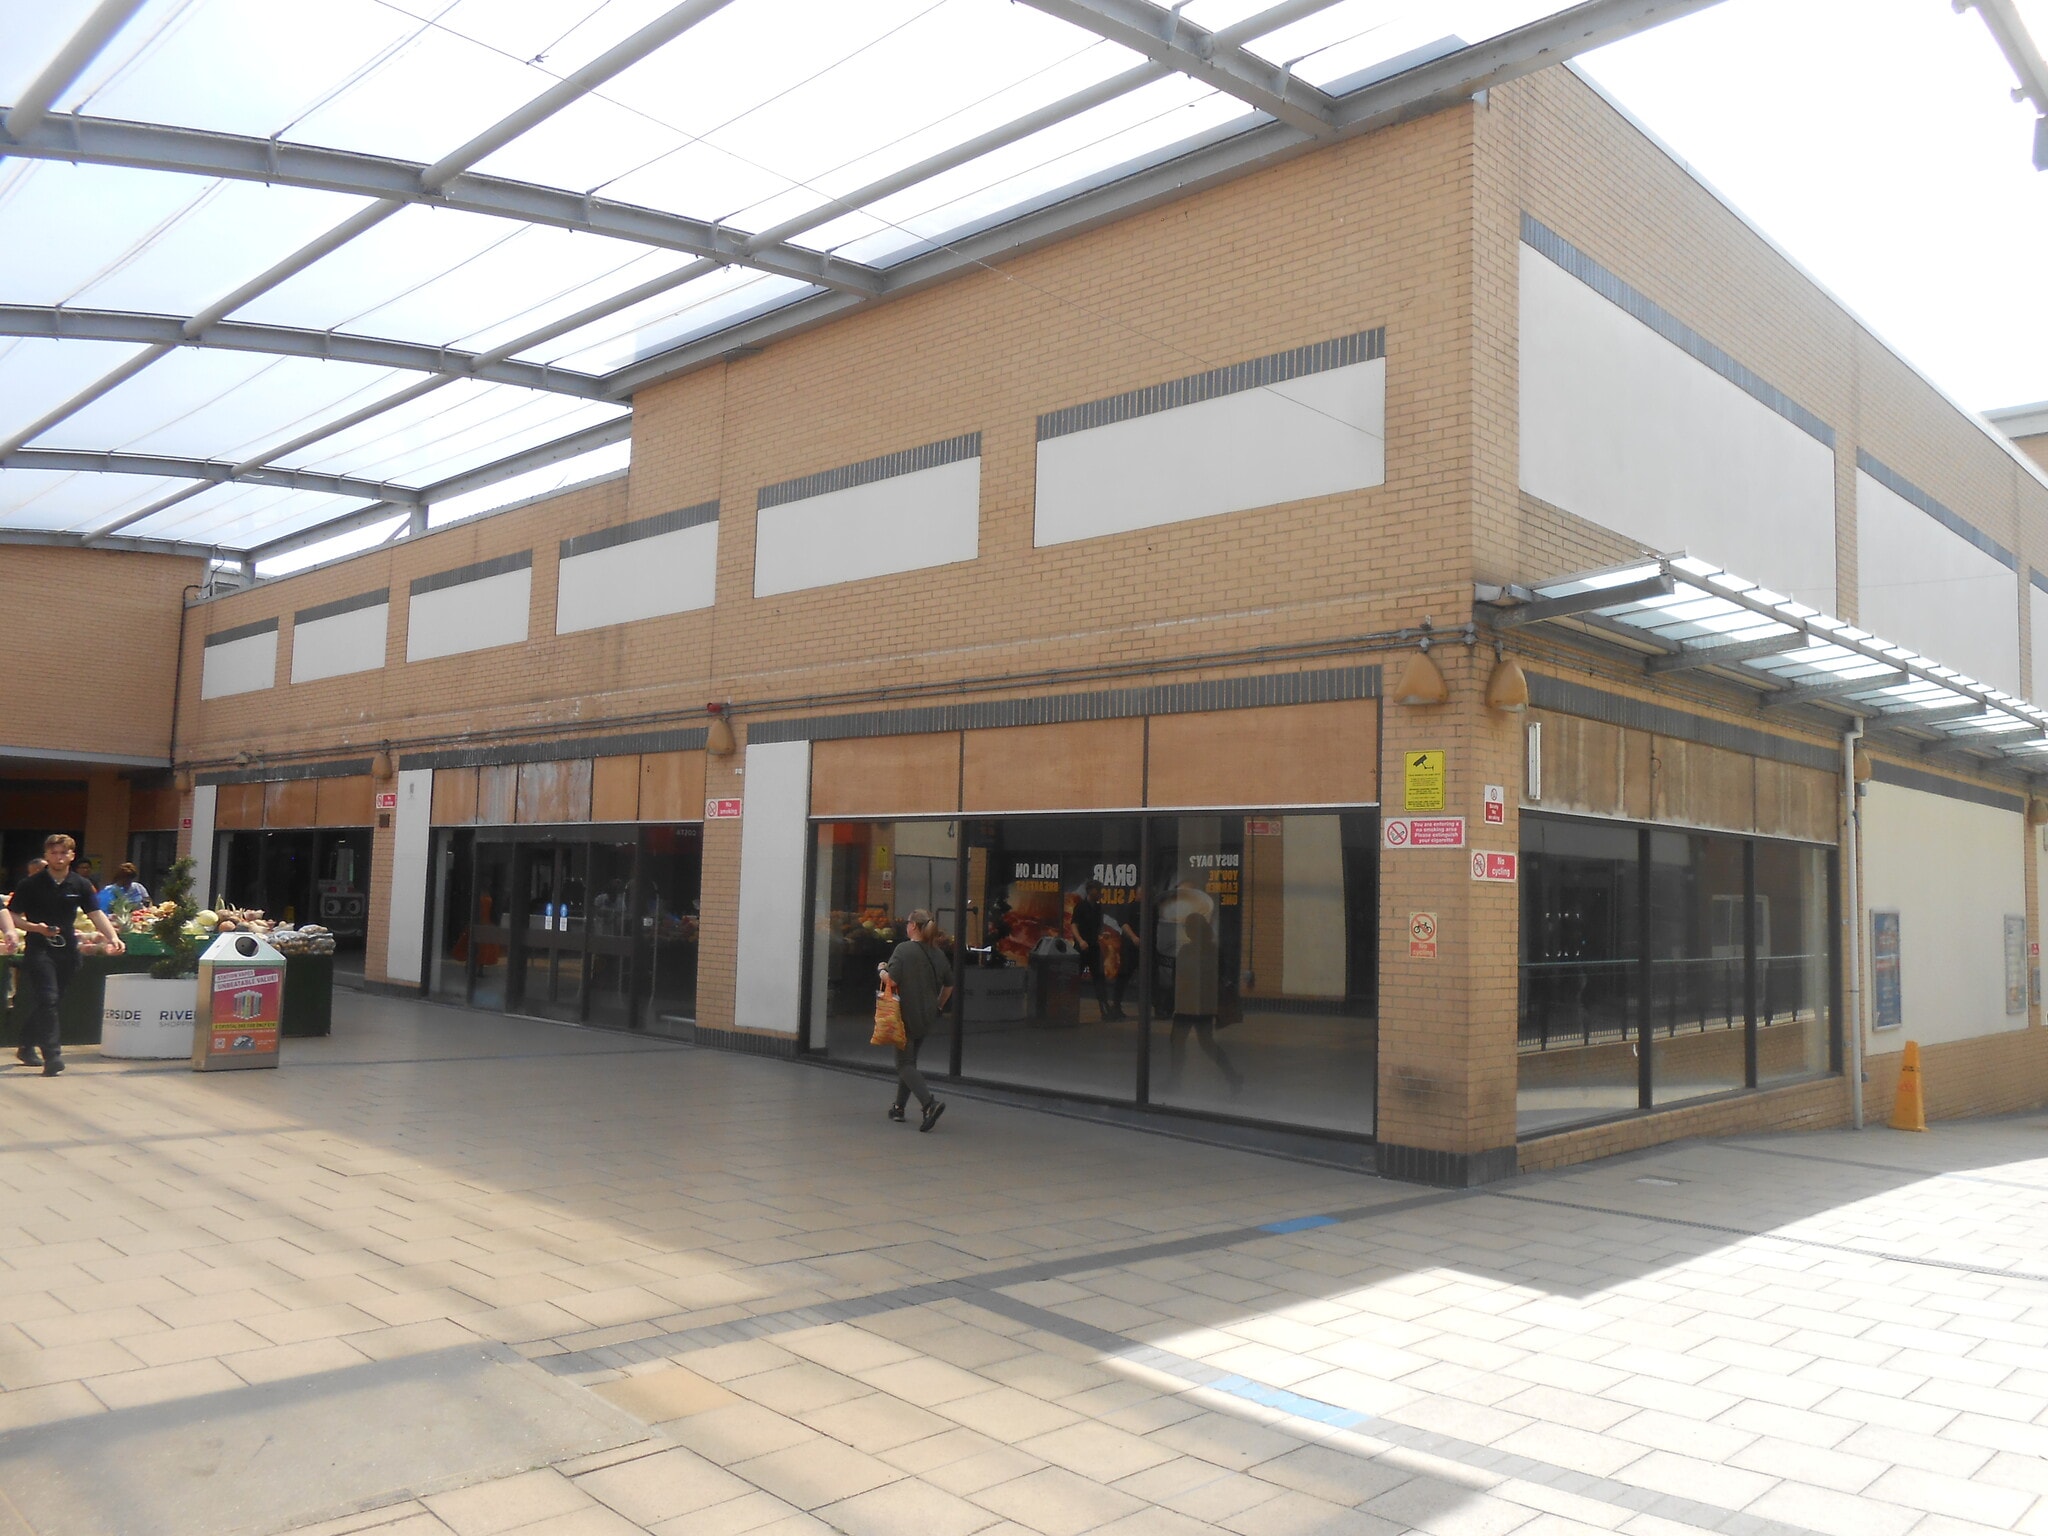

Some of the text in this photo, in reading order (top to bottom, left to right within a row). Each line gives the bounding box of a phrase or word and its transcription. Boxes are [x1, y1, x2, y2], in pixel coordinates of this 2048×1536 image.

[1497, 856, 1505, 865] No
[1491, 867, 1511, 877] cycling
[105, 1009, 196, 1020] ERSIDE RIVE
